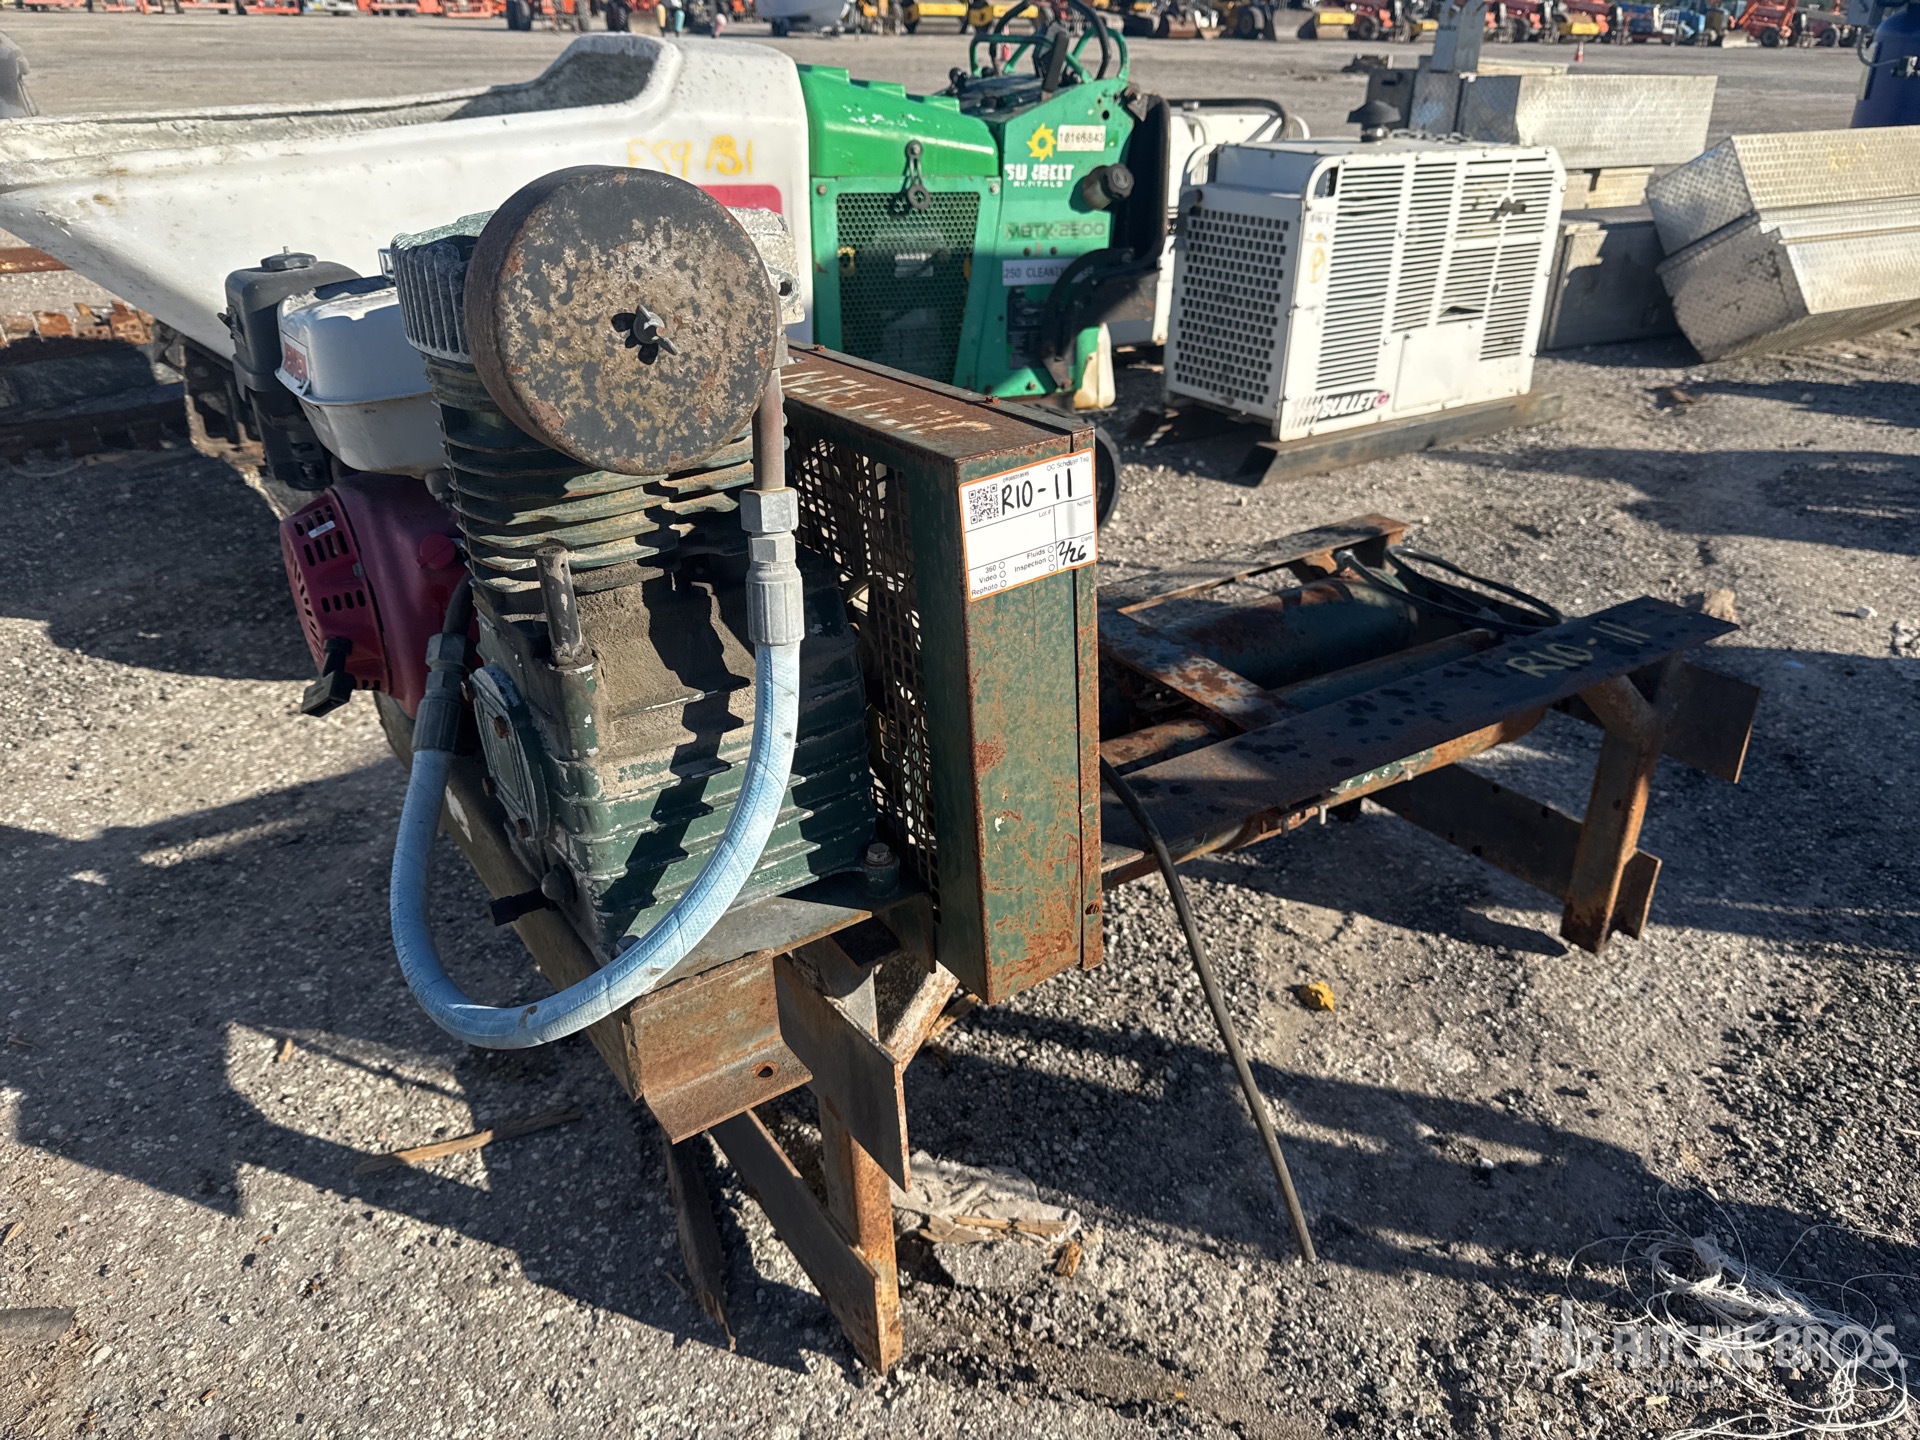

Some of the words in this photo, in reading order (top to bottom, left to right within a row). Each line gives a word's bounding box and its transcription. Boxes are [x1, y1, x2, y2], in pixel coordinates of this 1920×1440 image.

[1004, 163, 1074, 181] SUBELT
[1076, 499, 1091, 508] Notes
[1038, 510, 1048, 518] Lot
[1081, 534, 1093, 543] Date
[1027, 548, 1046, 560] Fluids
[1057, 541, 1087, 566] 2/26
[985, 564, 997, 574] 360
[1014, 557, 1047, 573] Inspection
[979, 573, 998, 584] Video
[971, 584, 998, 597] Rephoto
